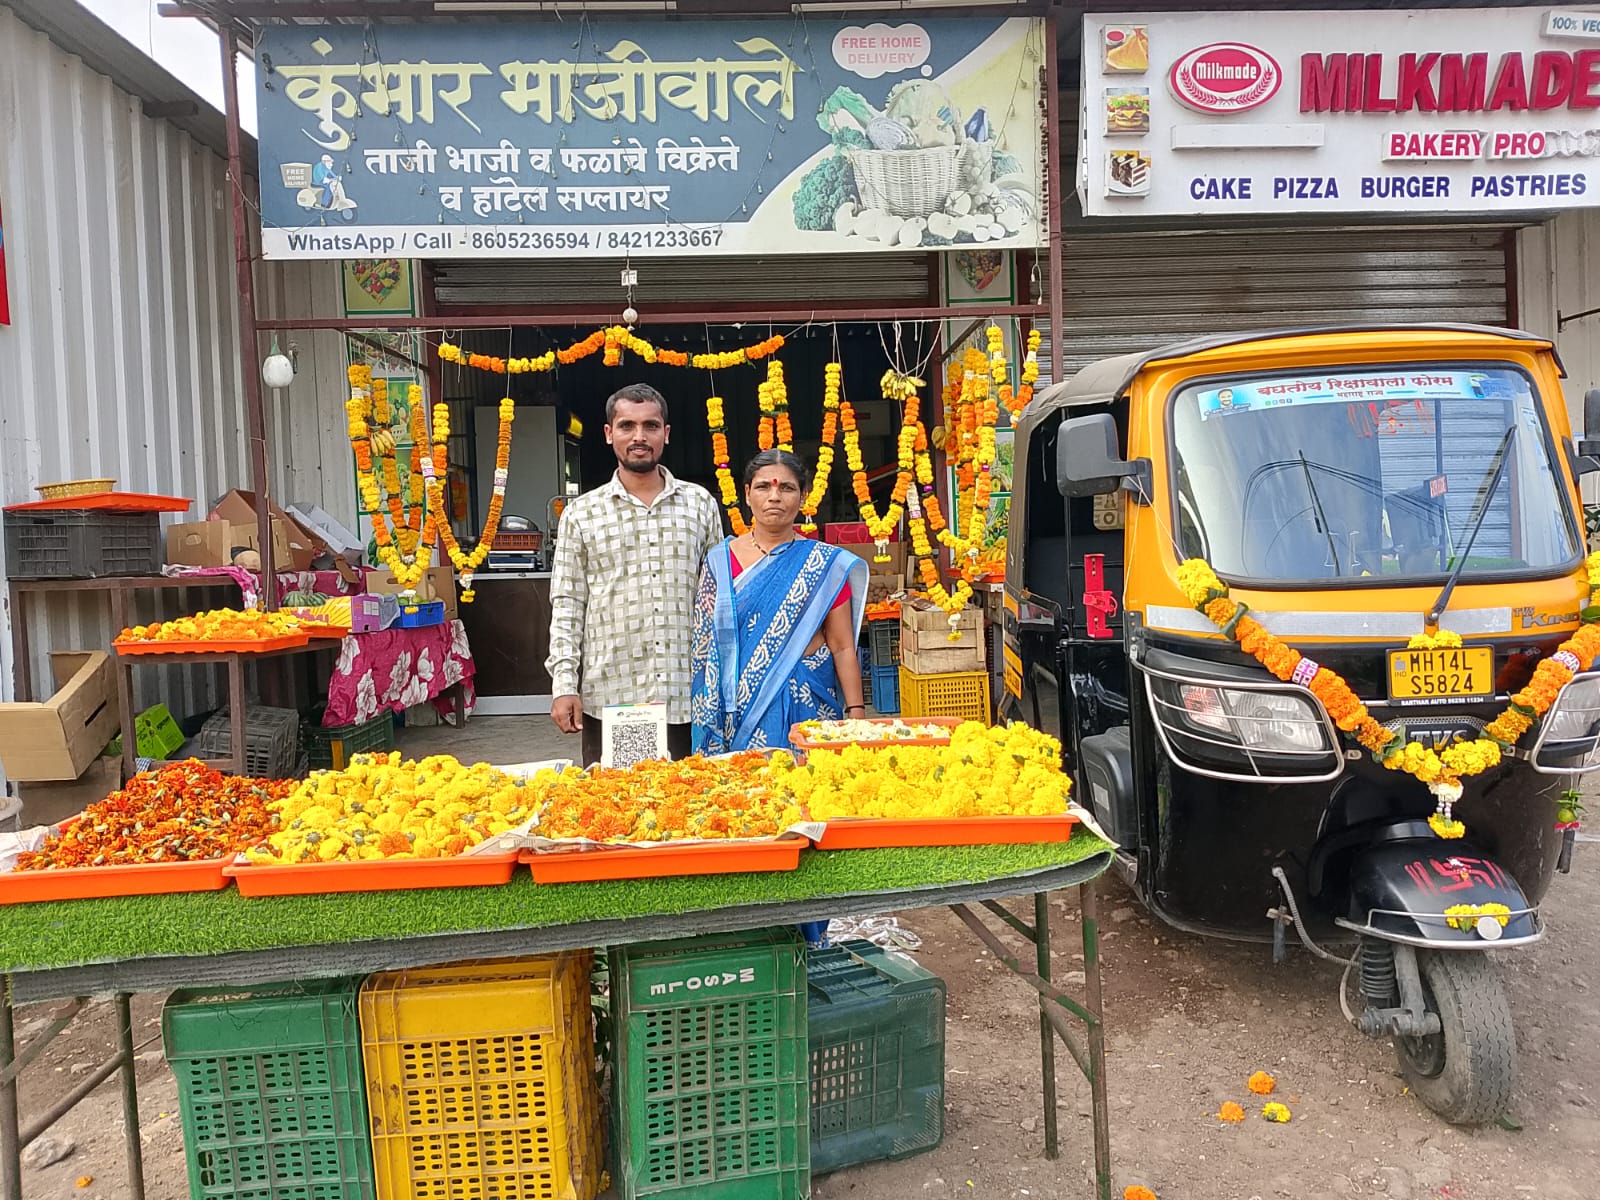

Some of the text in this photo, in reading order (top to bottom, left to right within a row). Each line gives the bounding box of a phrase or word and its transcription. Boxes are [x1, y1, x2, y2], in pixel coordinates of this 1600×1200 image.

[1552, 16, 1577, 31] 100%
[841, 36, 922, 49] FREE HOME
[847, 52, 915, 65] DELIVERY
[1195, 62, 1257, 80] Milkmade
[1299, 49, 1600, 113] MILKMADE
[274, 36, 493, 151] कुंभार
[363, 135, 741, 175] ताजी भाजी व फळांचे विक्रेते
[1390, 133, 1482, 157] BAKERY
[1190, 173, 1587, 200] CAKE PIZZA BURGER PASTRIES
[438, 186, 464, 212] व
[556, 185, 671, 213] सप्लायर
[287, 232, 395, 254] WhatsApp
[401, 233, 407, 250] /
[413, 232, 453, 250] Call
[472, 231, 590, 250] 8605236594
[596, 231, 602, 249] /
[607, 229, 724, 249] 8421233667
[1411, 373, 1454, 387] फोरम
[1410, 672, 1474, 695] S5824
